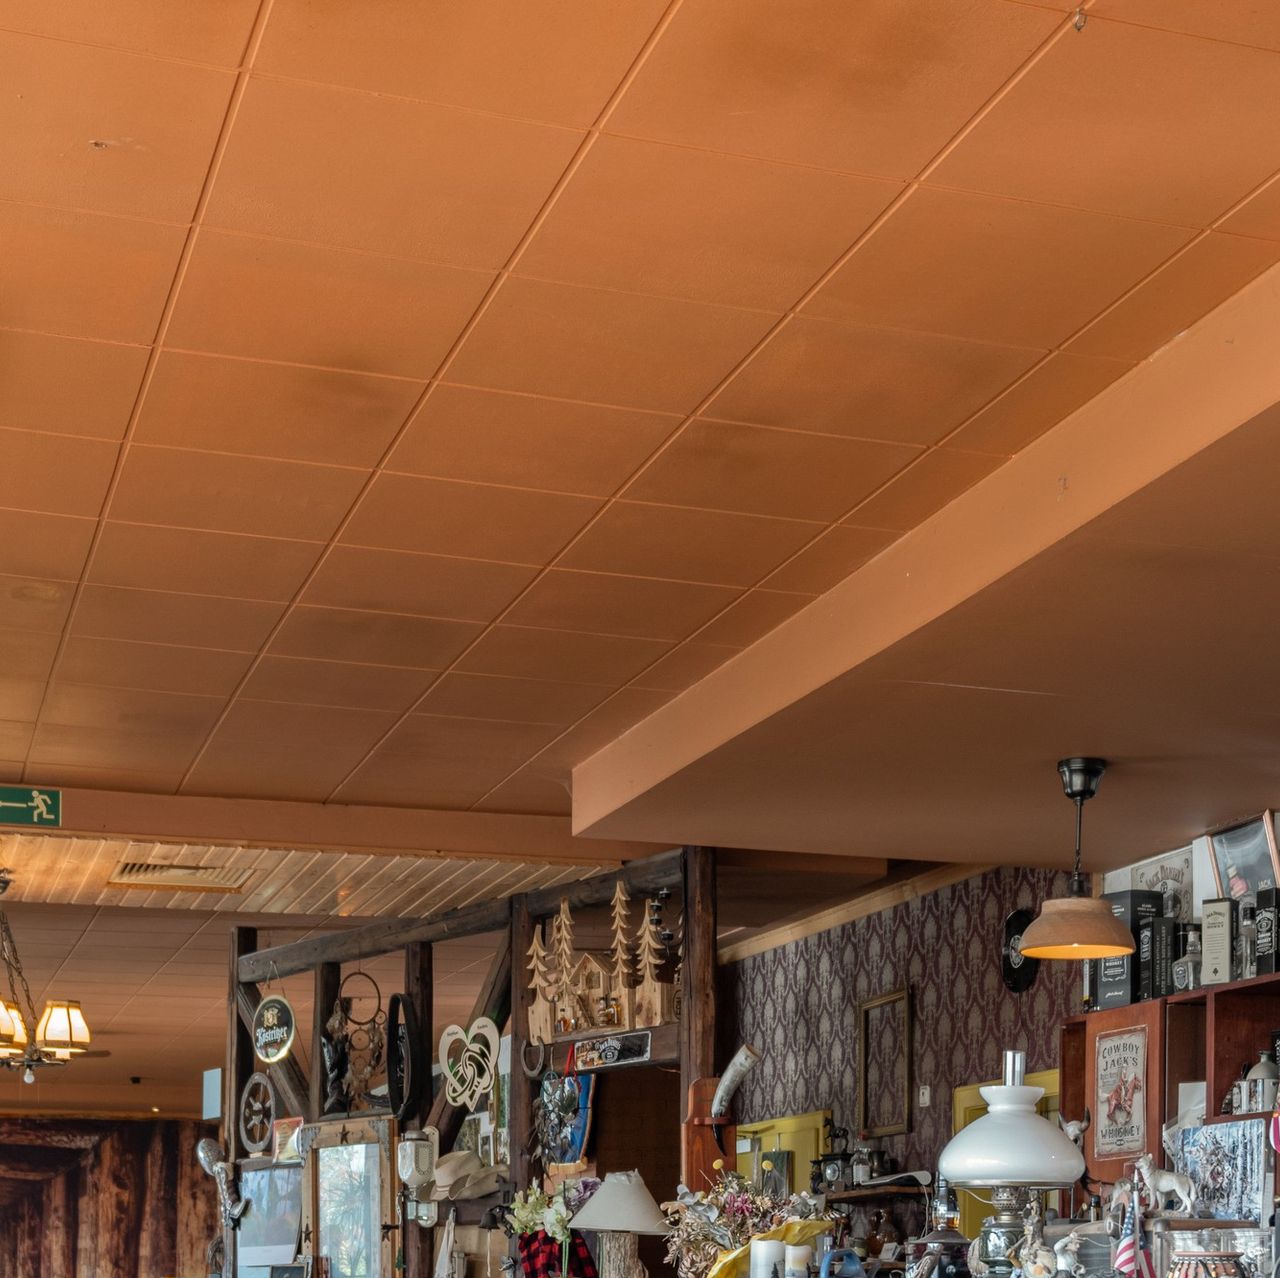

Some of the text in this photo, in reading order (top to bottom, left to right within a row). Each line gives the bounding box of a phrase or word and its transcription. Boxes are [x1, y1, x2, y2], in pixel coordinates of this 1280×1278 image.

[1258, 879, 1272, 890] JACK
[1102, 1043, 1140, 1059] COWBOY
[1103, 1056, 1138, 1072] JACK'S
[1101, 1125, 1141, 1139] WHISKEY
